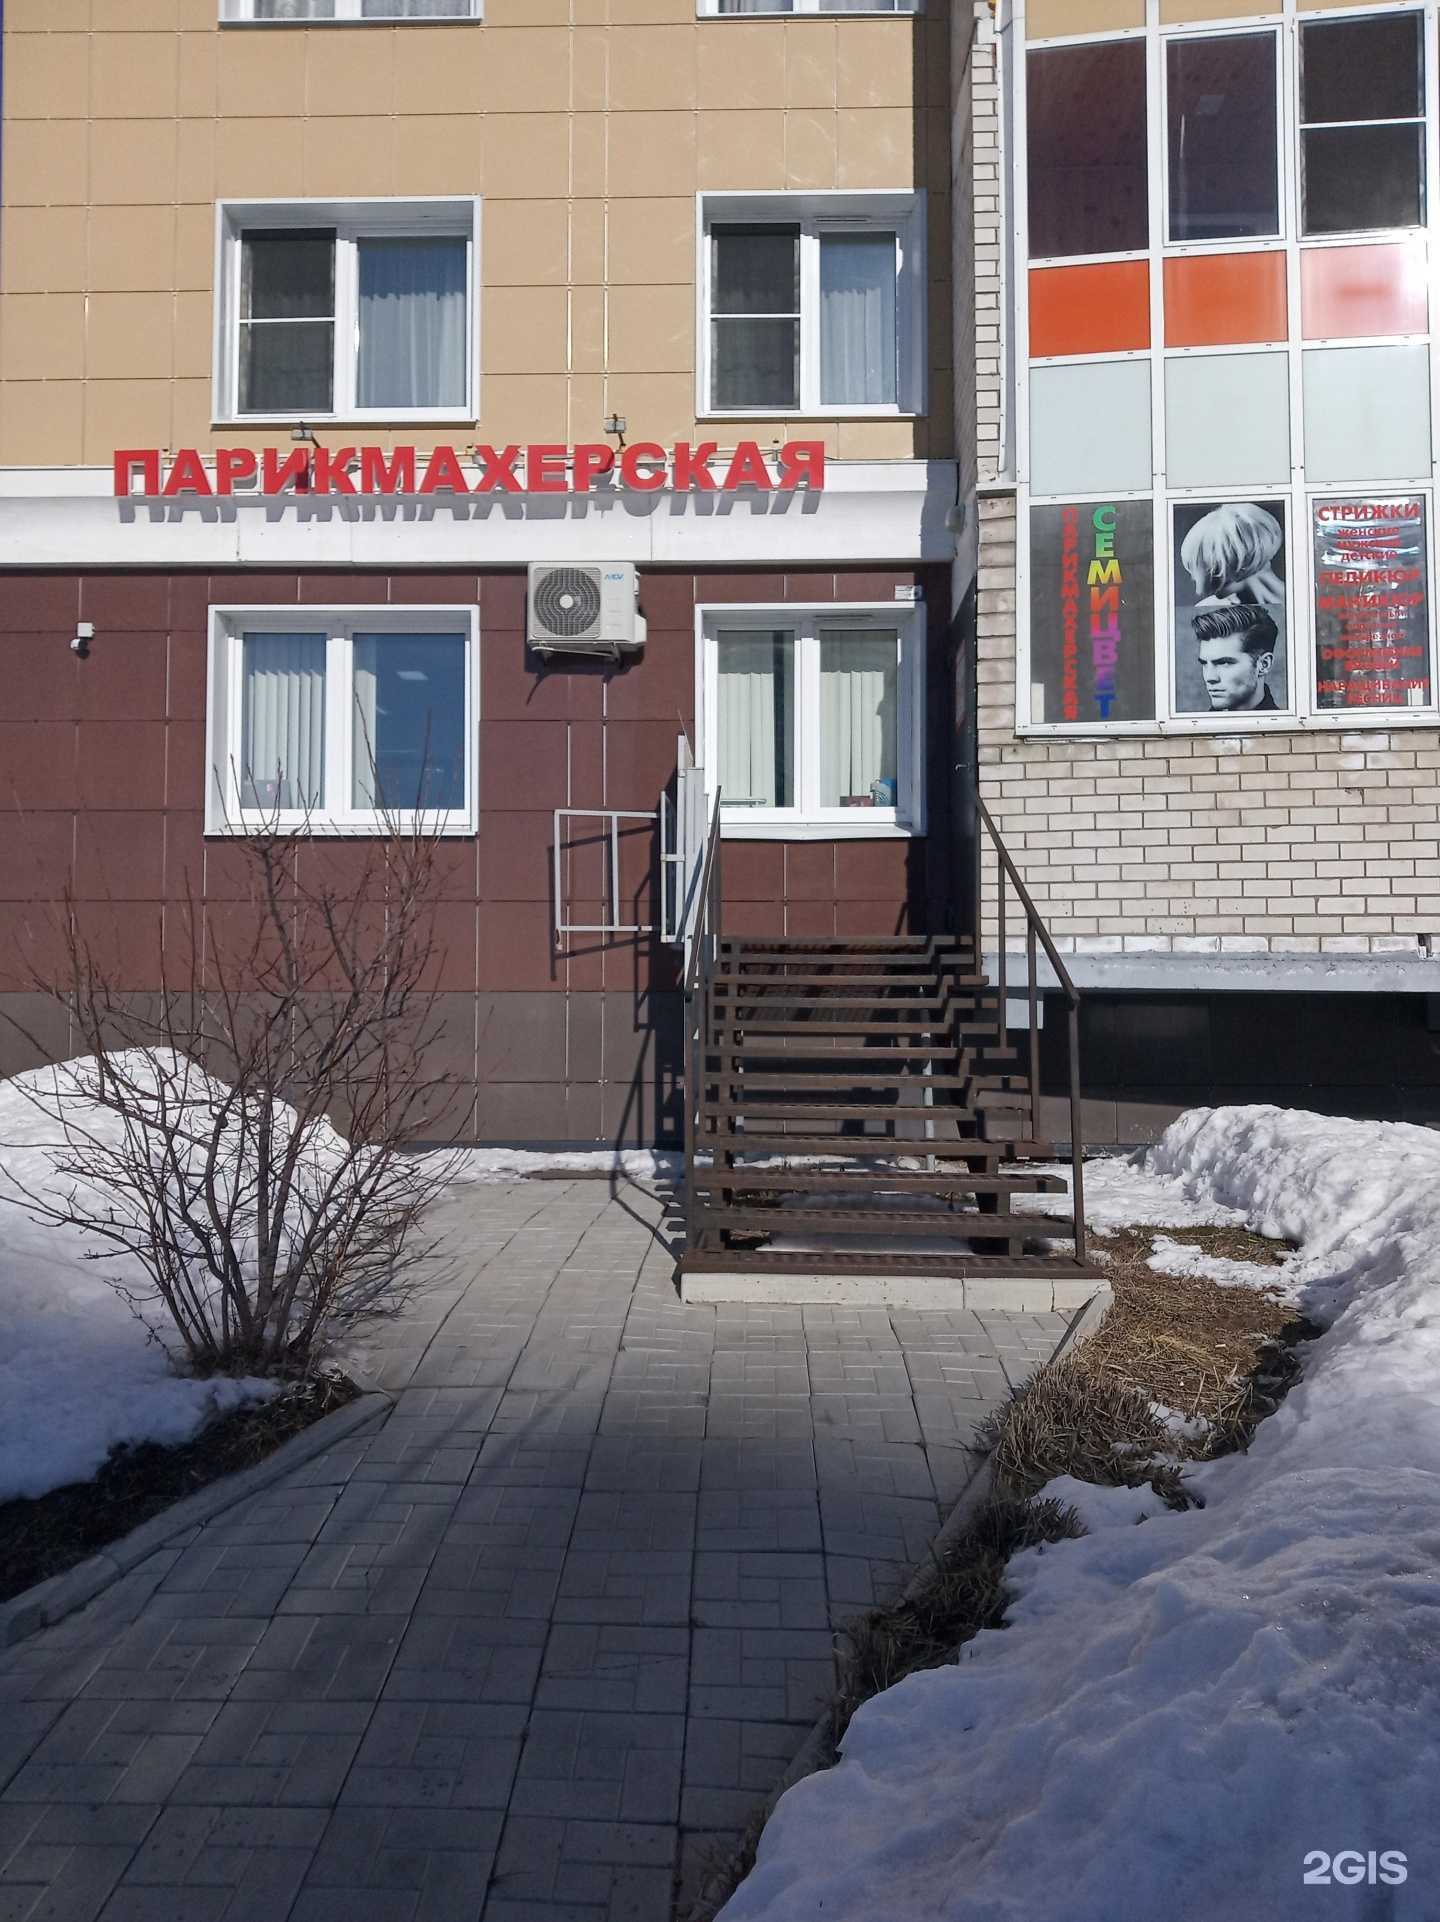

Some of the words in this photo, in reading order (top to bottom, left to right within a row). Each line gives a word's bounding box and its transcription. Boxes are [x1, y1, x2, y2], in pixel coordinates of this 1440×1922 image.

[114, 441, 825, 496] ПАРИКМАХЕРСКАЯ
[1317, 503, 1420, 521] СТРИЖКИ
[1087, 505, 1122, 720] СЕМИЦВЕТ
